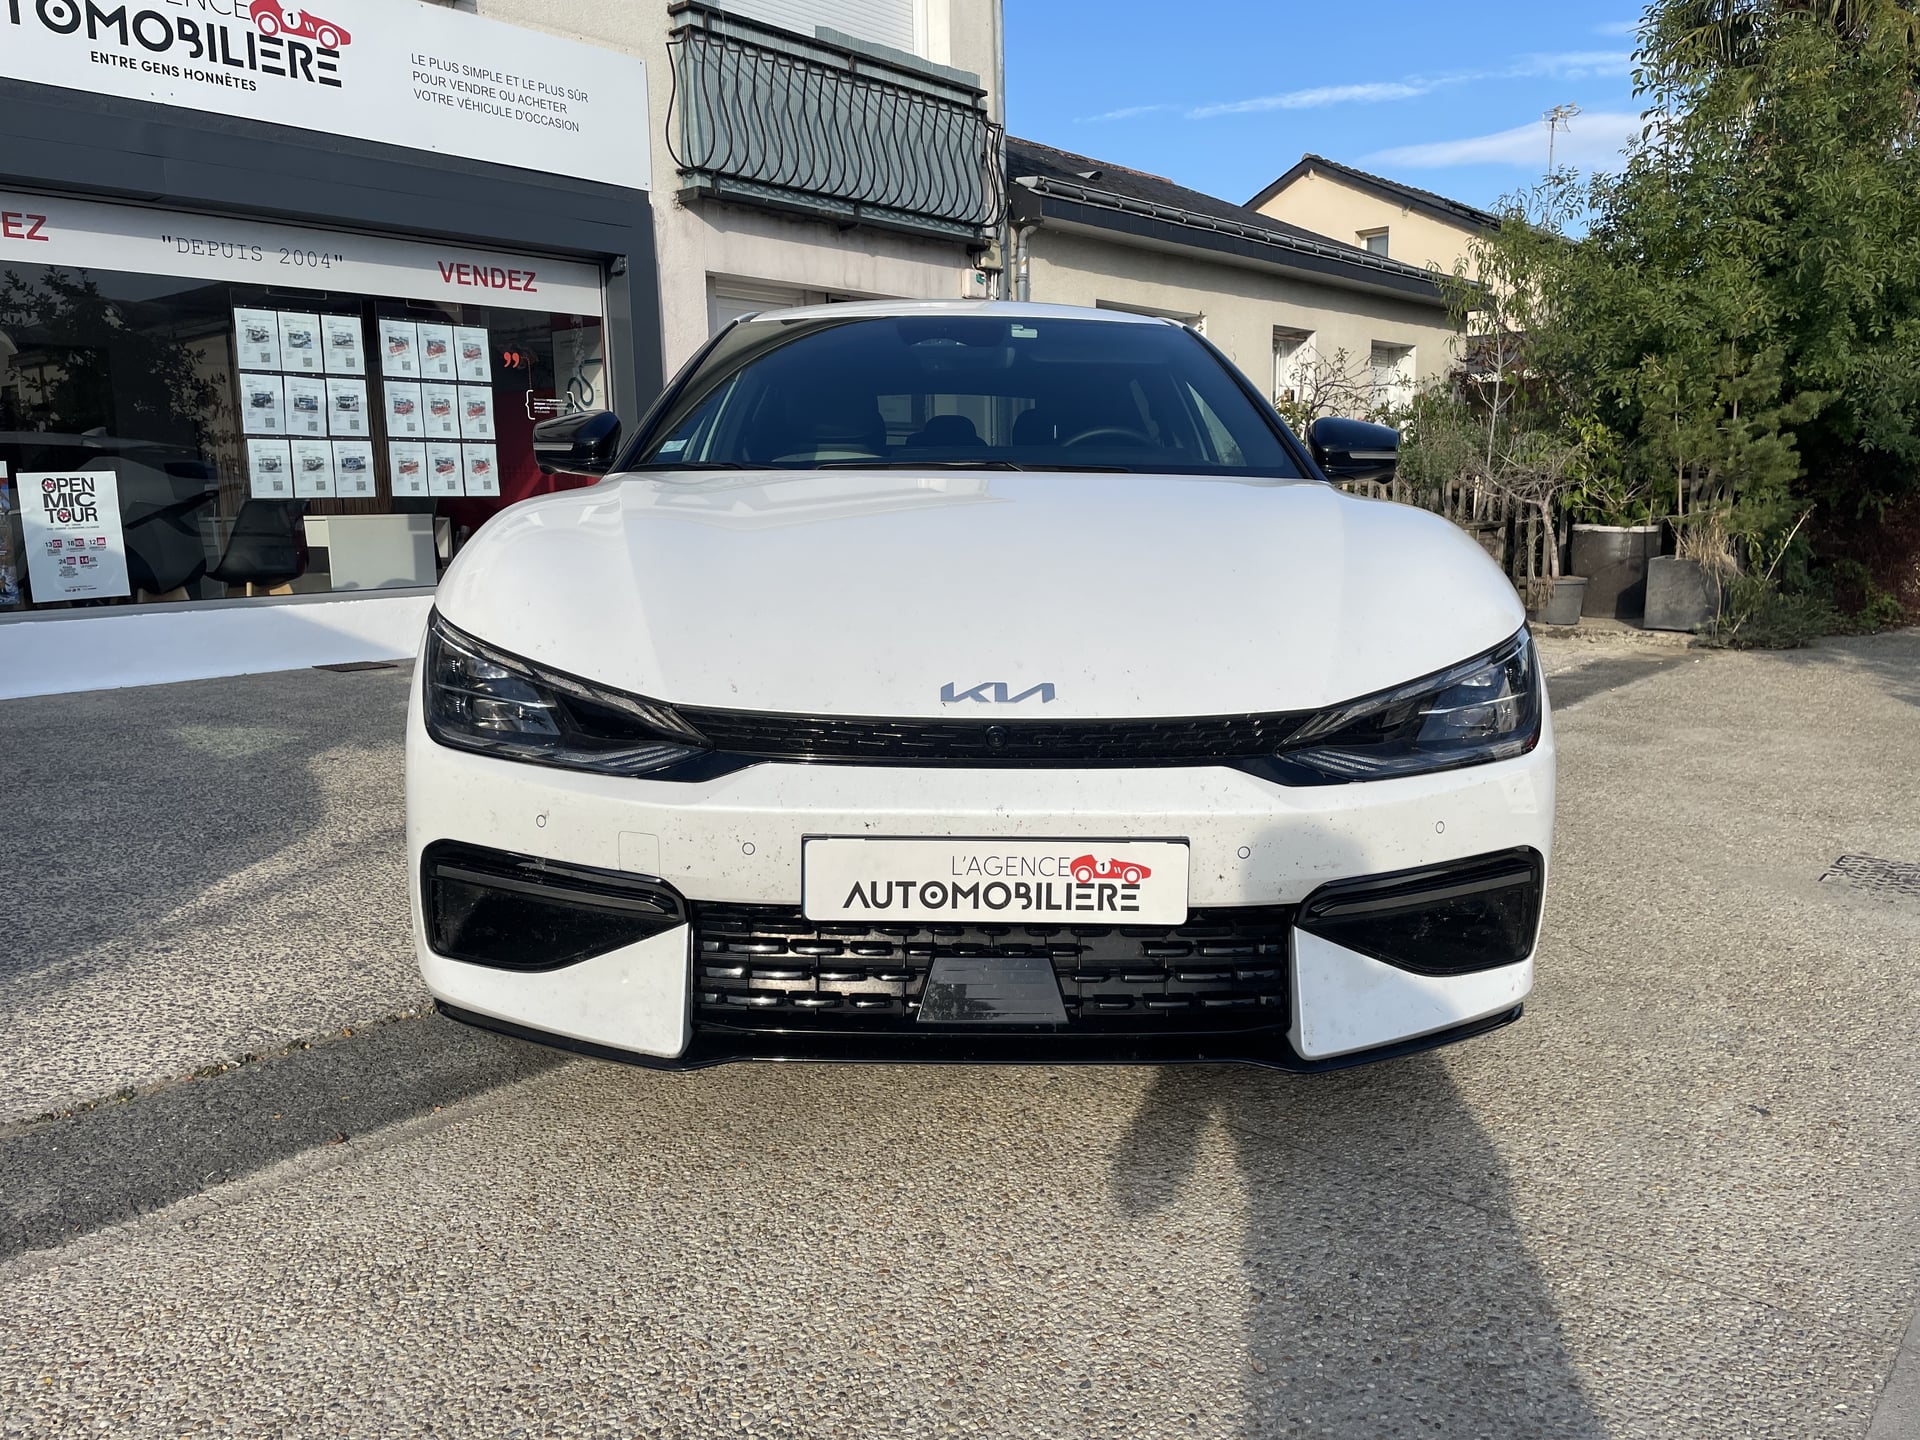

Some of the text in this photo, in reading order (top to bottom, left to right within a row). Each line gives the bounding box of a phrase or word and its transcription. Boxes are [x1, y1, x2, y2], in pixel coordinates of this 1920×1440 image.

[90, 51, 257, 91] ENTRE GENS HONNÊTES
[411, 53, 588, 103] LE PLUS SIMPLE ET LE PLUS SÛR
[412, 71, 567, 114] POUR VENDRE OU ACHETER
[413, 88, 579, 132] VOTRE VÉHICULE D'OCCASION
[2, 211, 49, 241] EZ
[437, 260, 538, 293] VENDEZ
[42, 477, 95, 493] OPEN
[43, 492, 96, 508] MIC
[45, 508, 98, 523] TOUR
[940, 681, 1056, 704] KIA
[952, 856, 1071, 877] L'AGENCE
